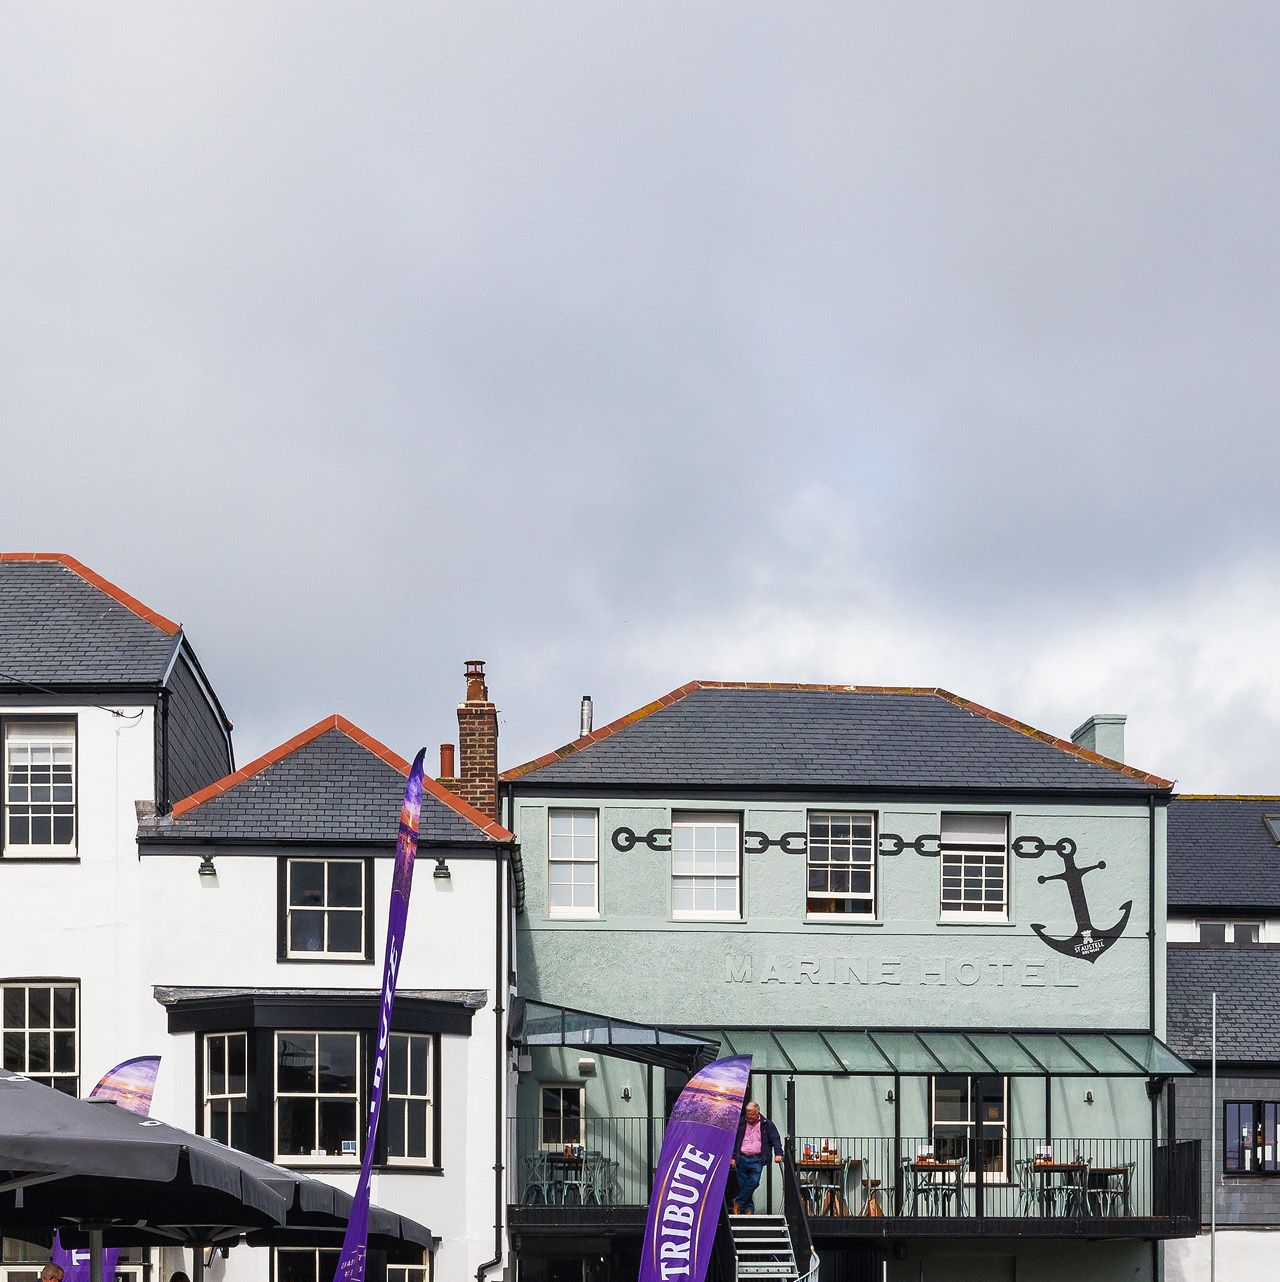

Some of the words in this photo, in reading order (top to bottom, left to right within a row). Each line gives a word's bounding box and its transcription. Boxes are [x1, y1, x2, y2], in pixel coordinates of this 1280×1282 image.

[725, 956, 901, 986] MARINE
[919, 957, 1079, 988] HOTEL
[660, 1143, 715, 1281] TRIBUTE
